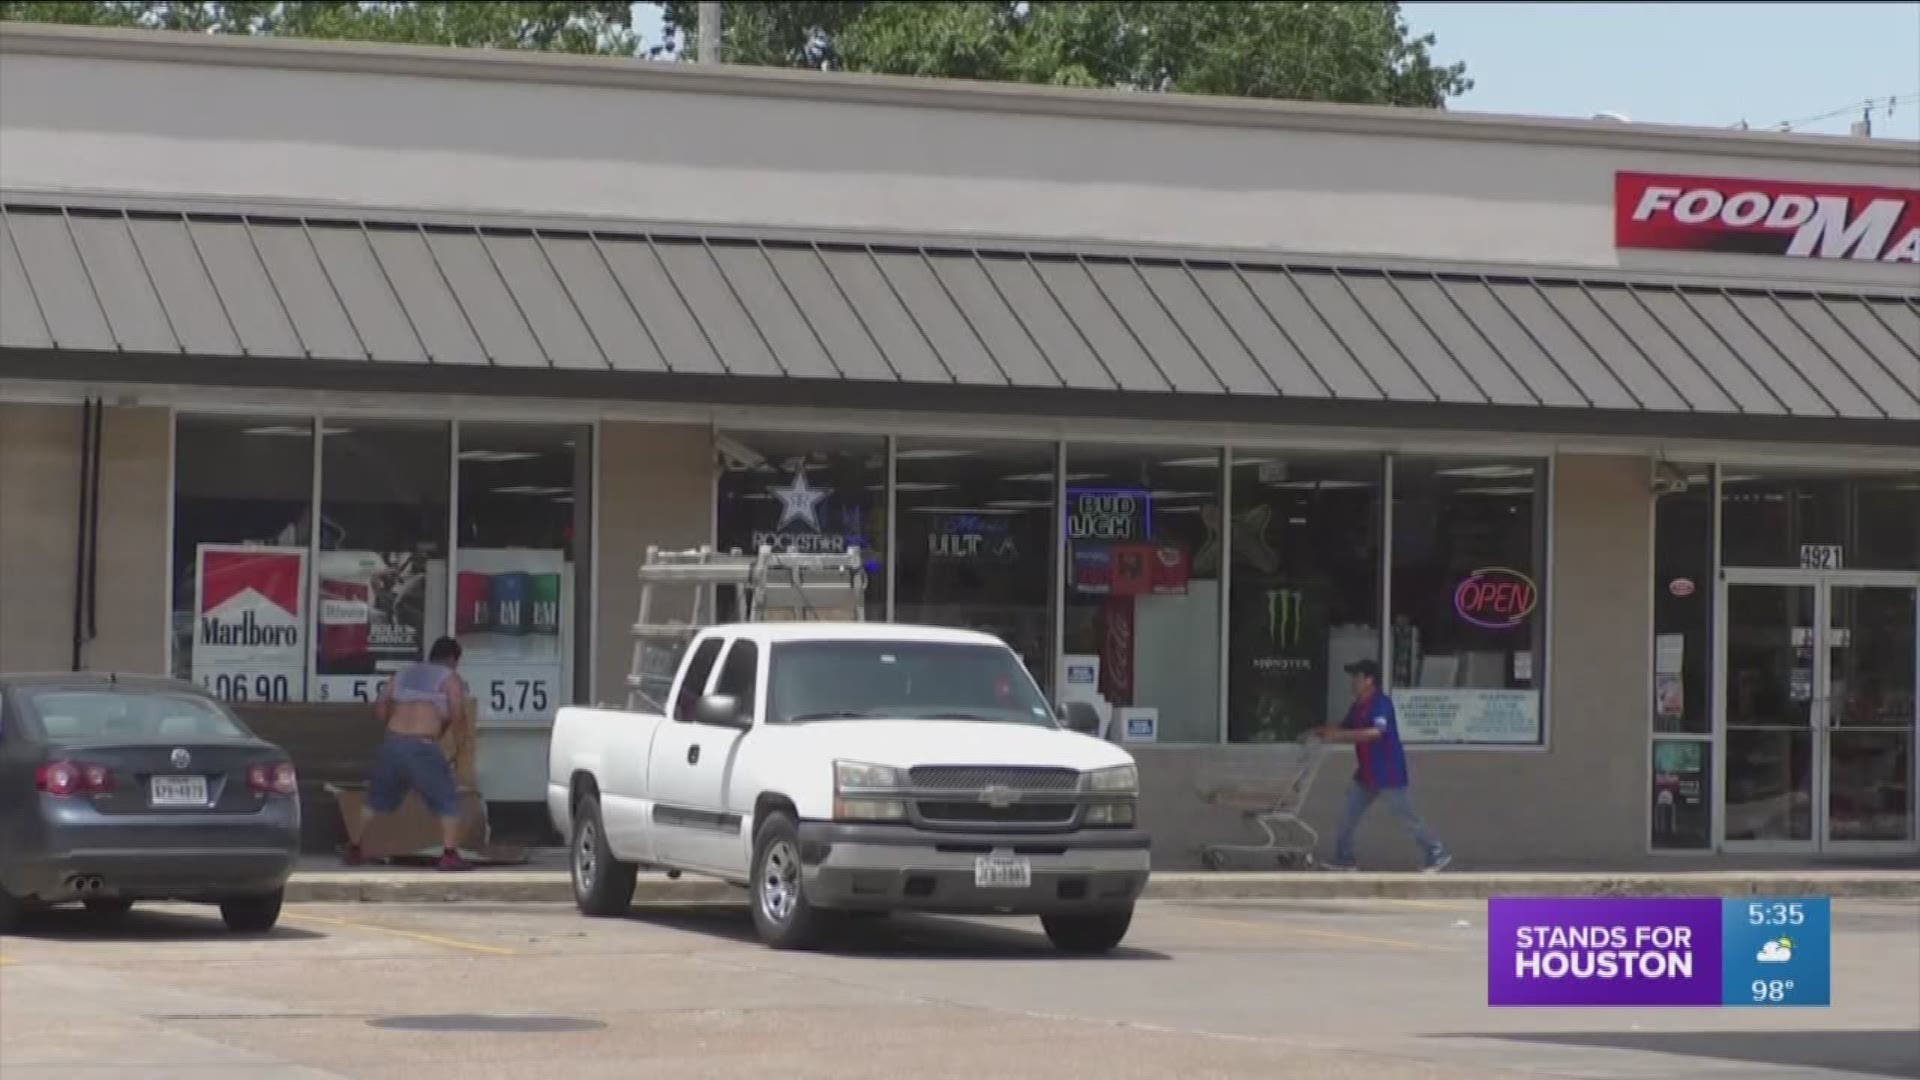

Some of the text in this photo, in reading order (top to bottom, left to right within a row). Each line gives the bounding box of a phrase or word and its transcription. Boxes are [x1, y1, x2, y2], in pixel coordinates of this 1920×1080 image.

[1080, 494, 1136, 516] BUD
[927, 533, 1019, 557] ULTA
[1801, 546, 1841, 569] 4921
[1461, 582, 1530, 612] OPEN
[201, 609, 297, 647] Marlboro
[491, 680, 547, 713] 5.75
